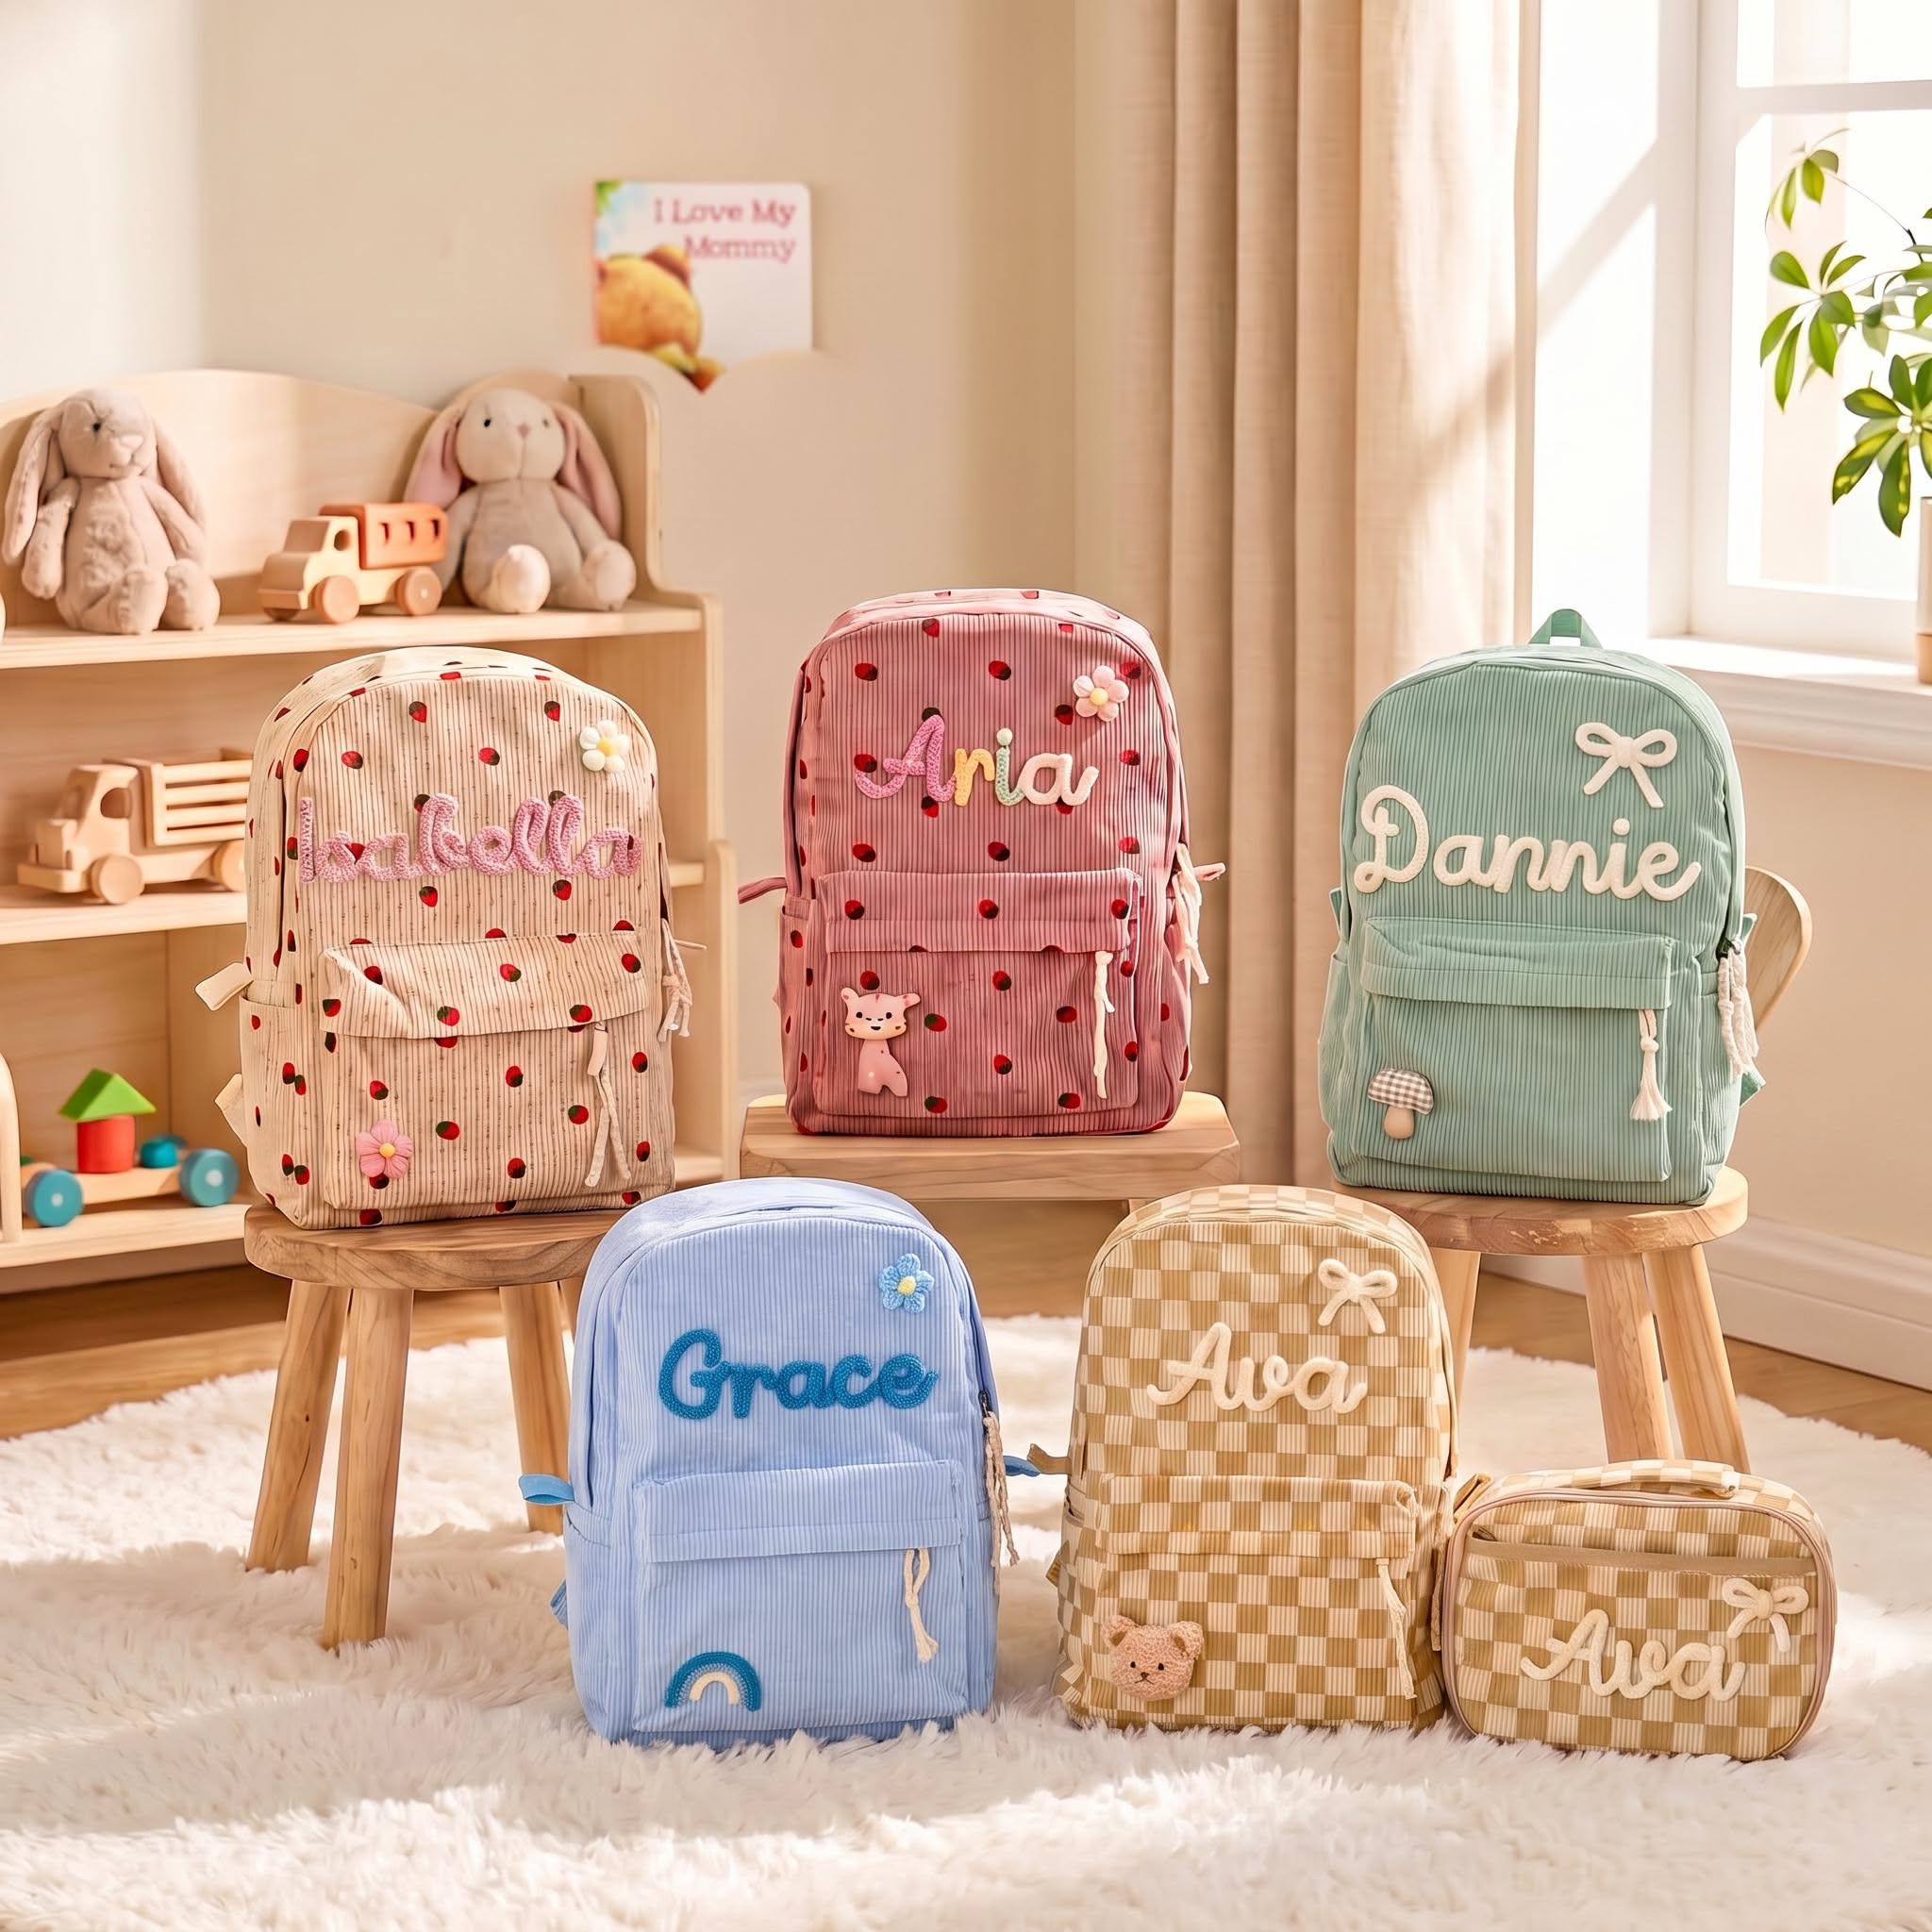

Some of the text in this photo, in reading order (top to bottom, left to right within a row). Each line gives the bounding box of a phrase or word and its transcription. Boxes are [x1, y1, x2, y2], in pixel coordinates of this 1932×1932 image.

[653, 198, 797, 228] I Love My
[684, 236, 796, 264] Mommy
[855, 714, 1099, 807] Aria
[1354, 784, 1702, 901] Dannie
[658, 1328, 939, 1420] Grace
[1146, 1322, 1368, 1414] Ava
[1521, 1608, 1746, 1701] Ava
